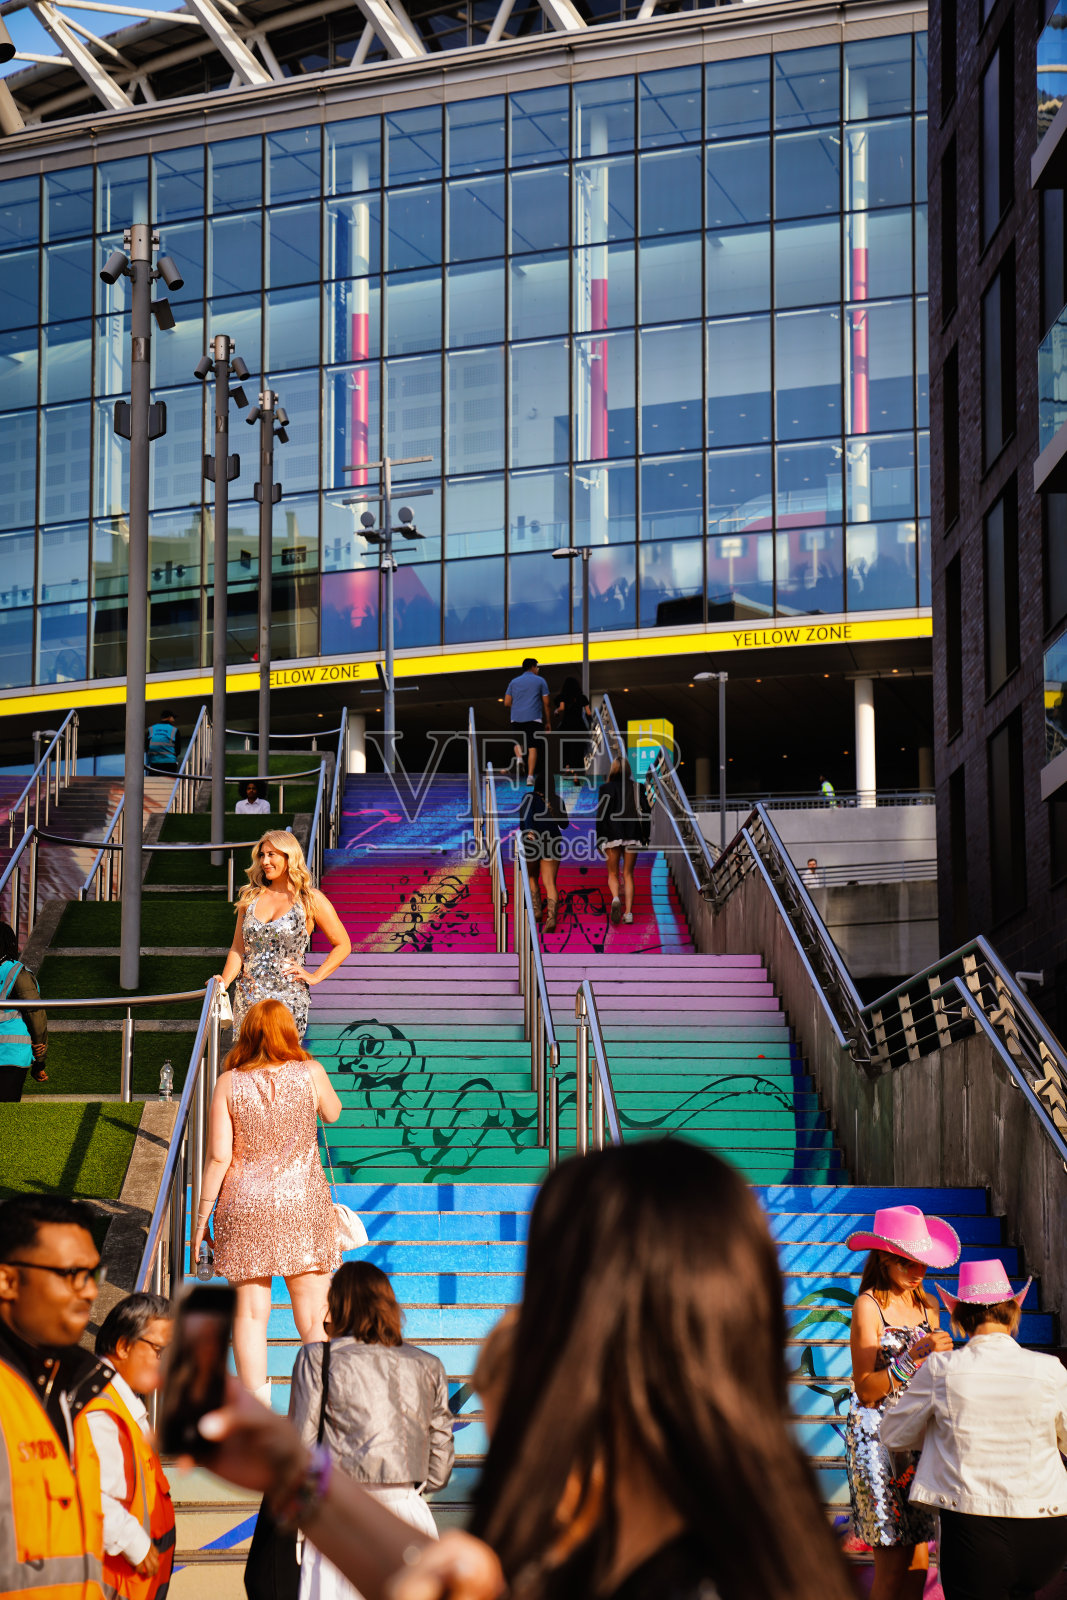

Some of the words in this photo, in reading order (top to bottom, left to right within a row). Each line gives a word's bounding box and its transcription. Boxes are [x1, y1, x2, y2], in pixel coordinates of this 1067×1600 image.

[733, 629, 800, 647] YELLOW
[806, 625, 852, 642] ZONE
[259, 669, 316, 686] ELLOW
[320, 664, 360, 681] ZONE
